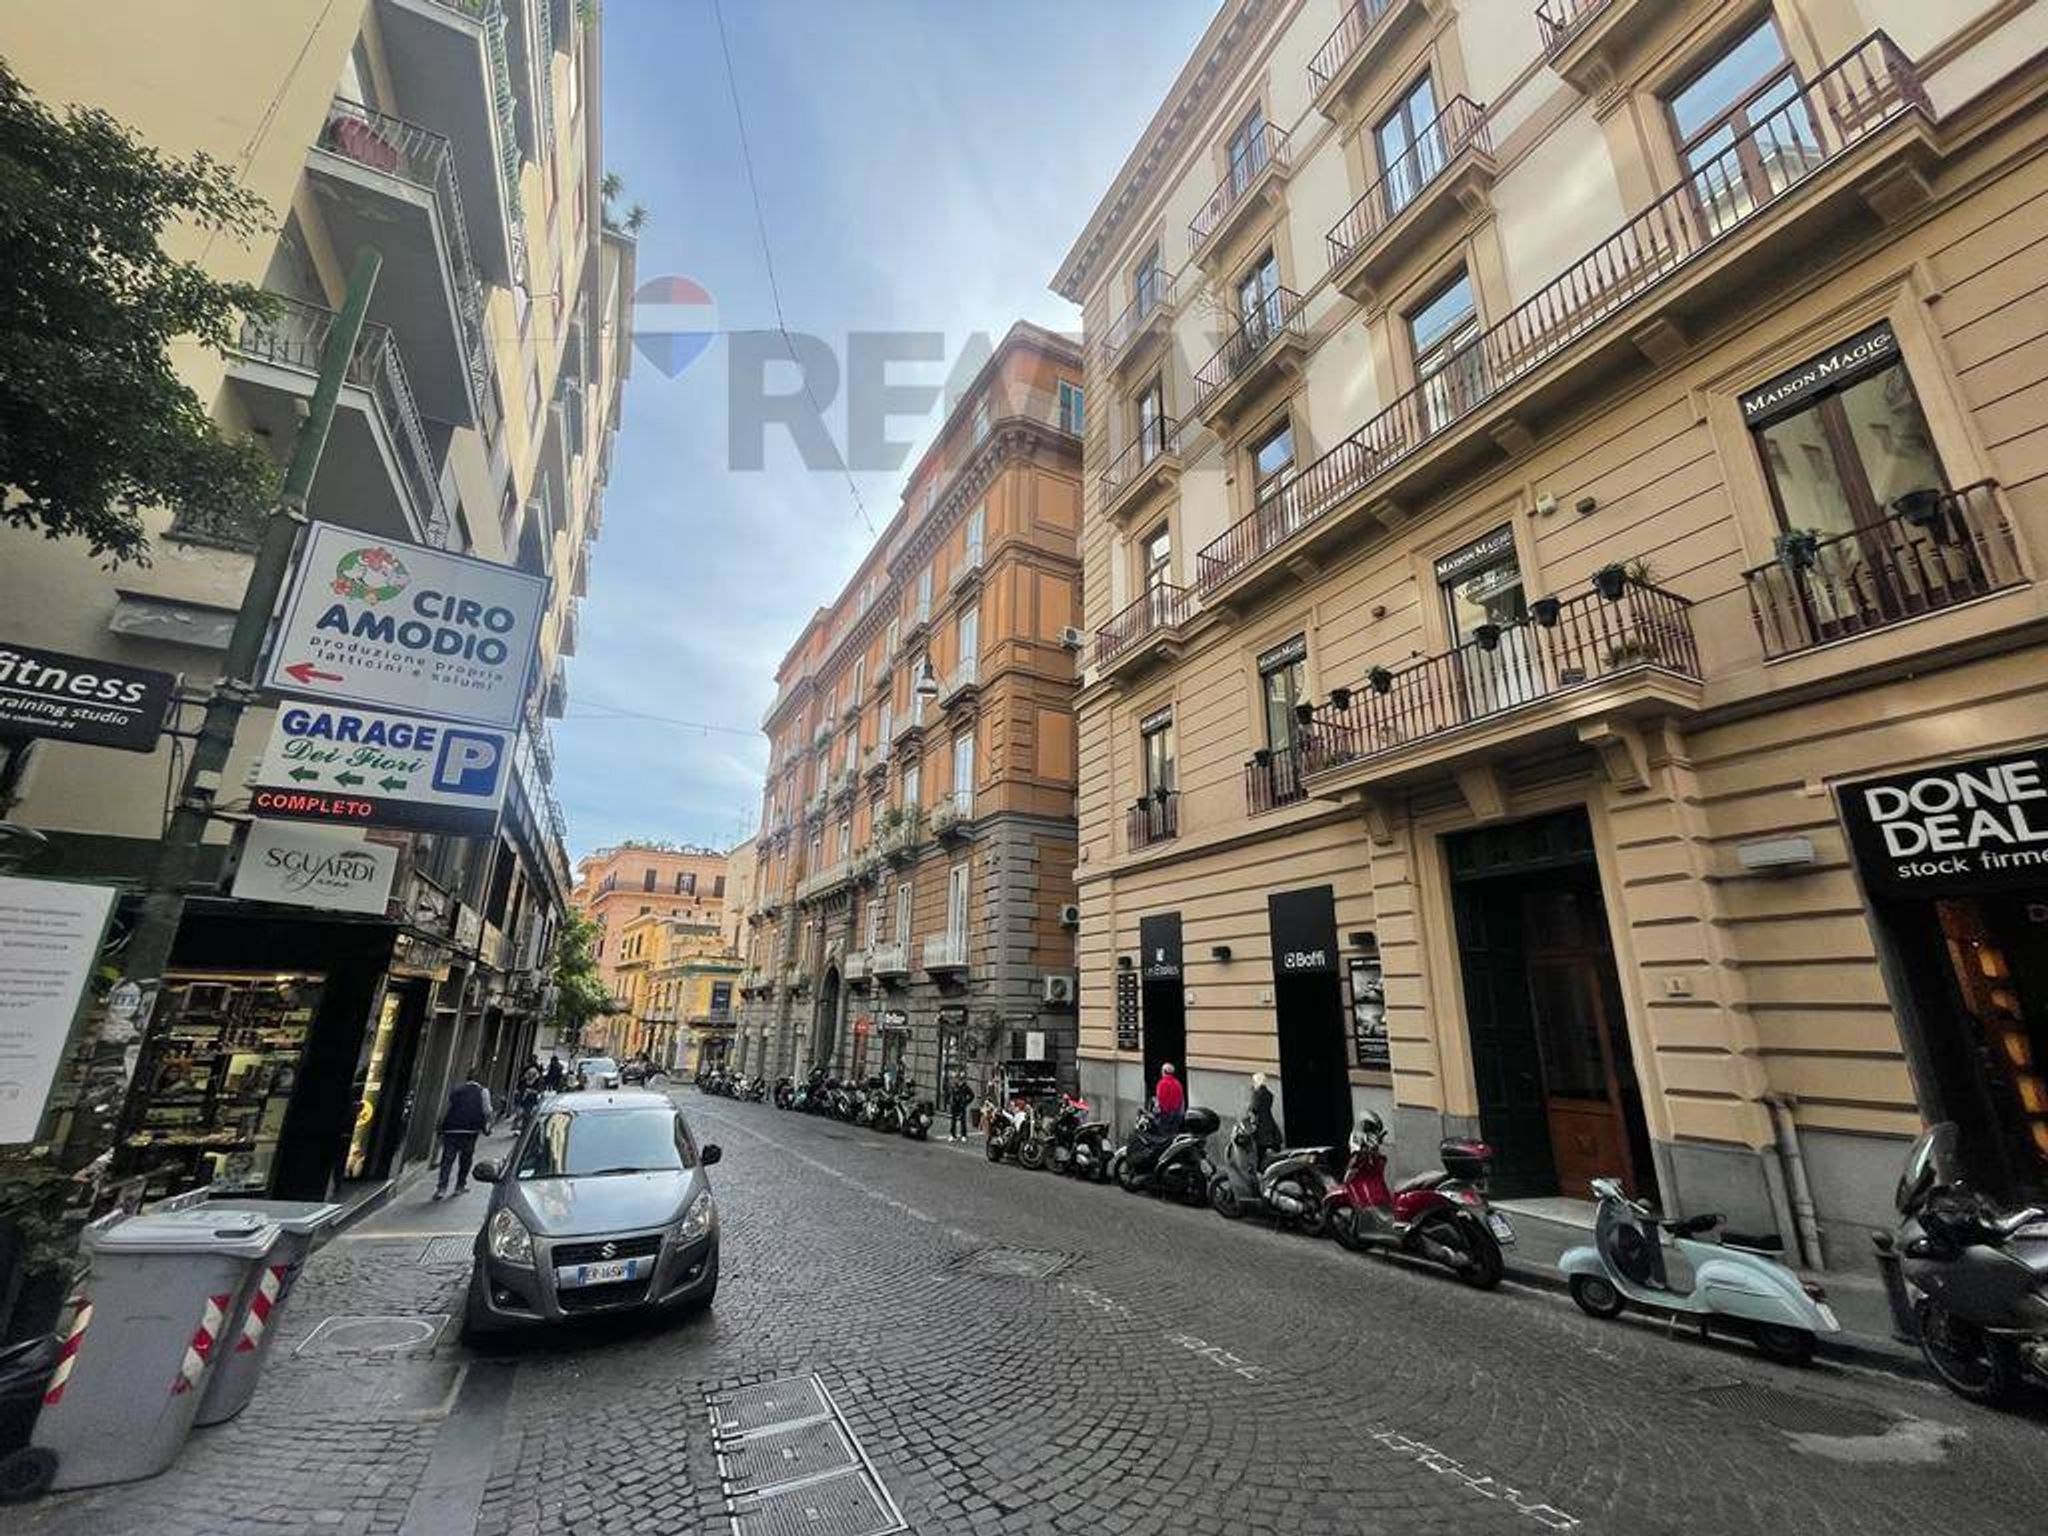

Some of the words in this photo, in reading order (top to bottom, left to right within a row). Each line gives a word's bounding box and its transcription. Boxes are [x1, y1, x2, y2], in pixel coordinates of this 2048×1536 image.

[413, 589, 515, 633] CIRO
[316, 603, 508, 666] AMODIO
[310, 636, 426, 667] produzione
[435, 661, 503, 682] propria
[71, 708, 130, 726] studio
[281, 708, 437, 751] GARAGE
[282, 737, 341, 765] Dei
[346, 746, 427, 773] Fiori
[441, 736, 499, 786] P
[257, 793, 373, 817] COMPLETO
[1863, 760, 2047, 822] DONE
[1880, 804, 2048, 858] DEAL
[264, 847, 375, 887] SGUARDI
[1898, 855, 1970, 879] stock
